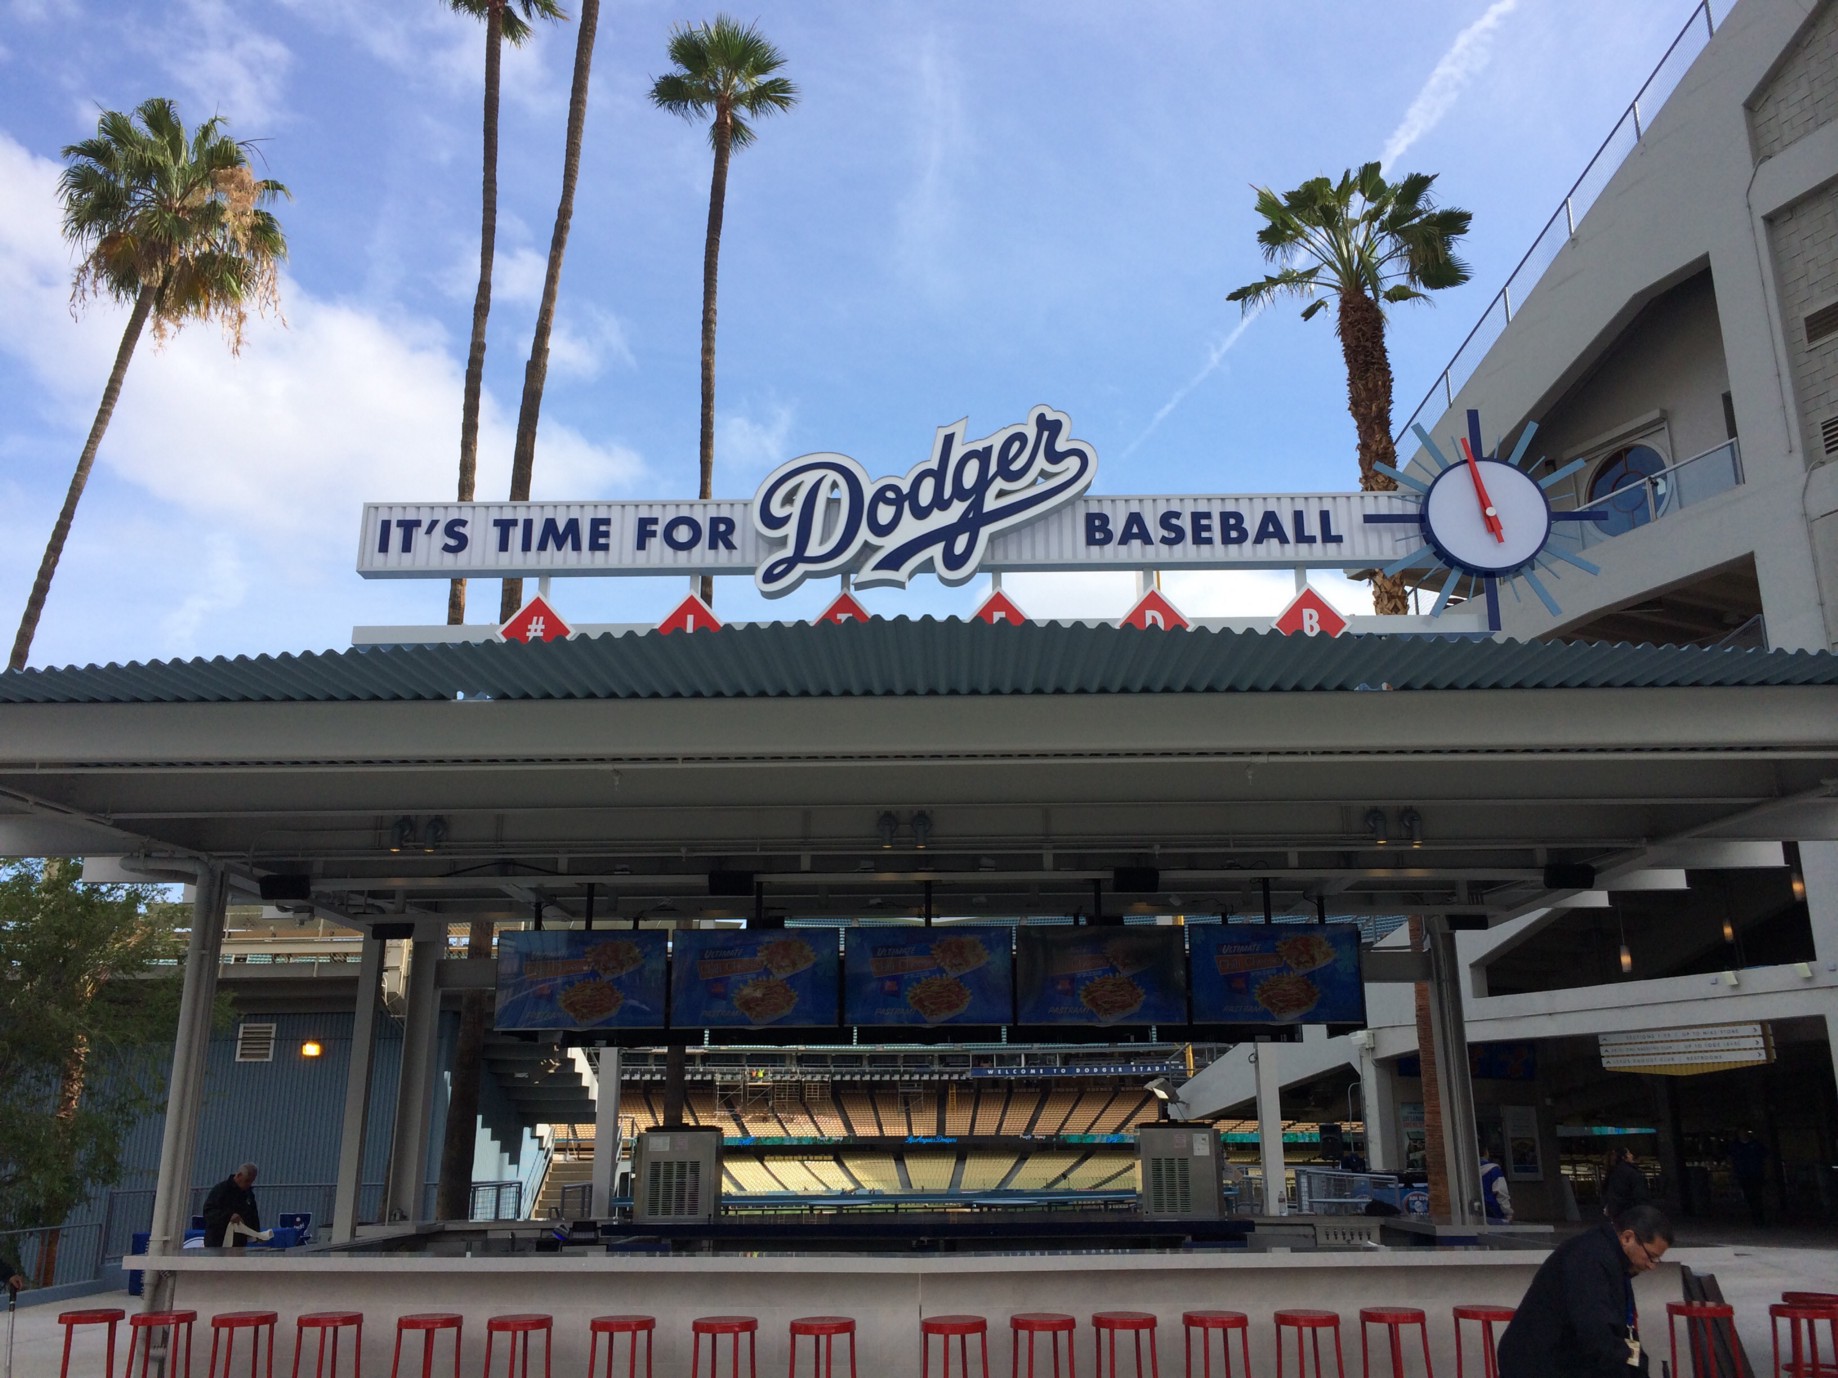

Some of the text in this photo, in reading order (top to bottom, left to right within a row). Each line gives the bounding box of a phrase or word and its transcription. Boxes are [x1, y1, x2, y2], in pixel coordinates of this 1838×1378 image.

[378, 412, 1344, 588] IT'S TIME FOR Dodger BASEBALL
[1302, 608, 1320, 637] B
[1076, 1066, 1123, 1074] DODGER
